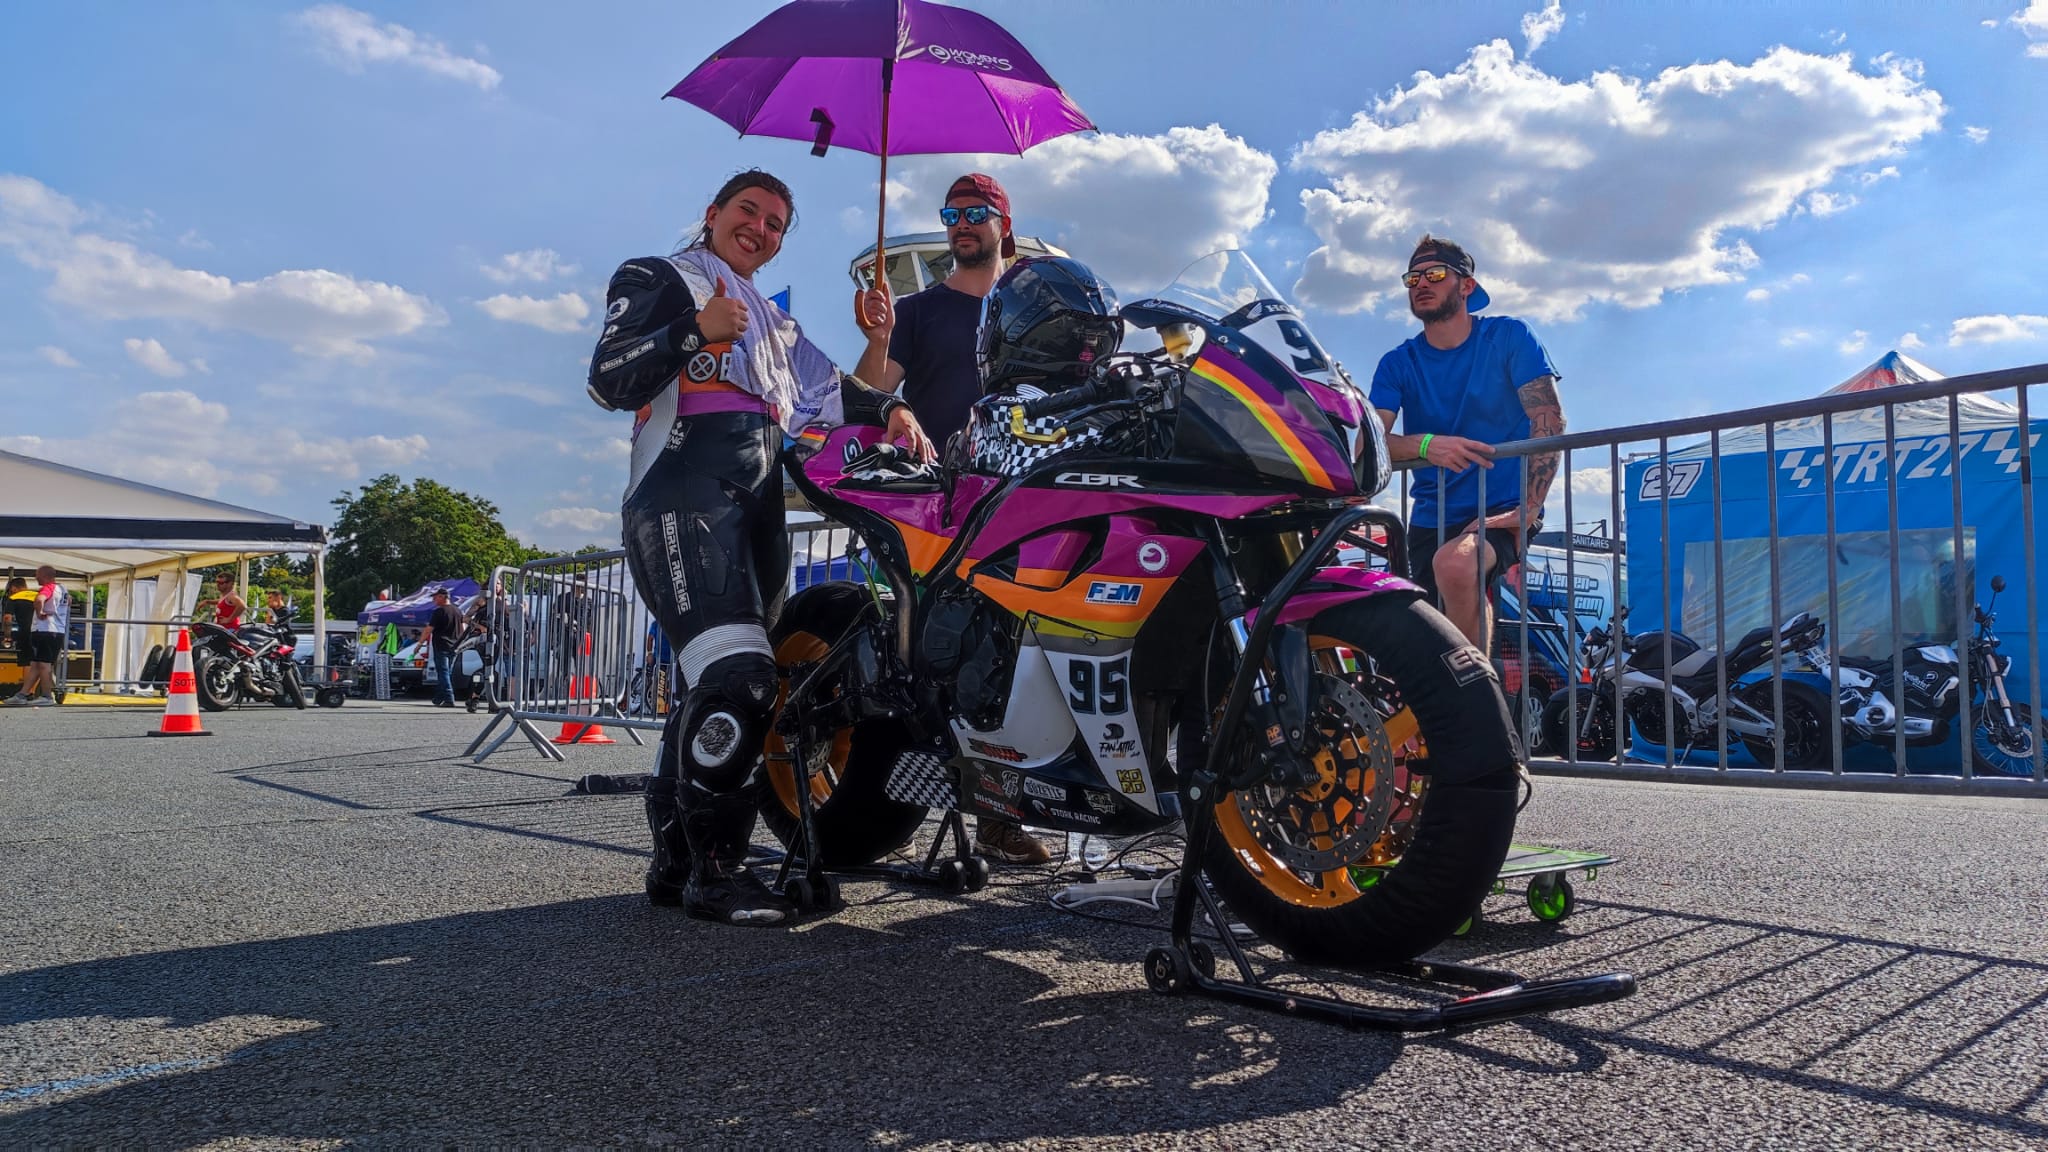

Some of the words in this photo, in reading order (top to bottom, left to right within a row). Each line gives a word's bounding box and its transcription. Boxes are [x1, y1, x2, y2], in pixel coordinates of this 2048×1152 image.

[1275, 319, 1329, 375] 9
[1055, 472, 1145, 489] CBR
[1640, 460, 1705, 501] 27
[1829, 434, 1984, 486] TRT27
[1068, 656, 1129, 716] 95
[1073, 812, 1101, 825] RACING
